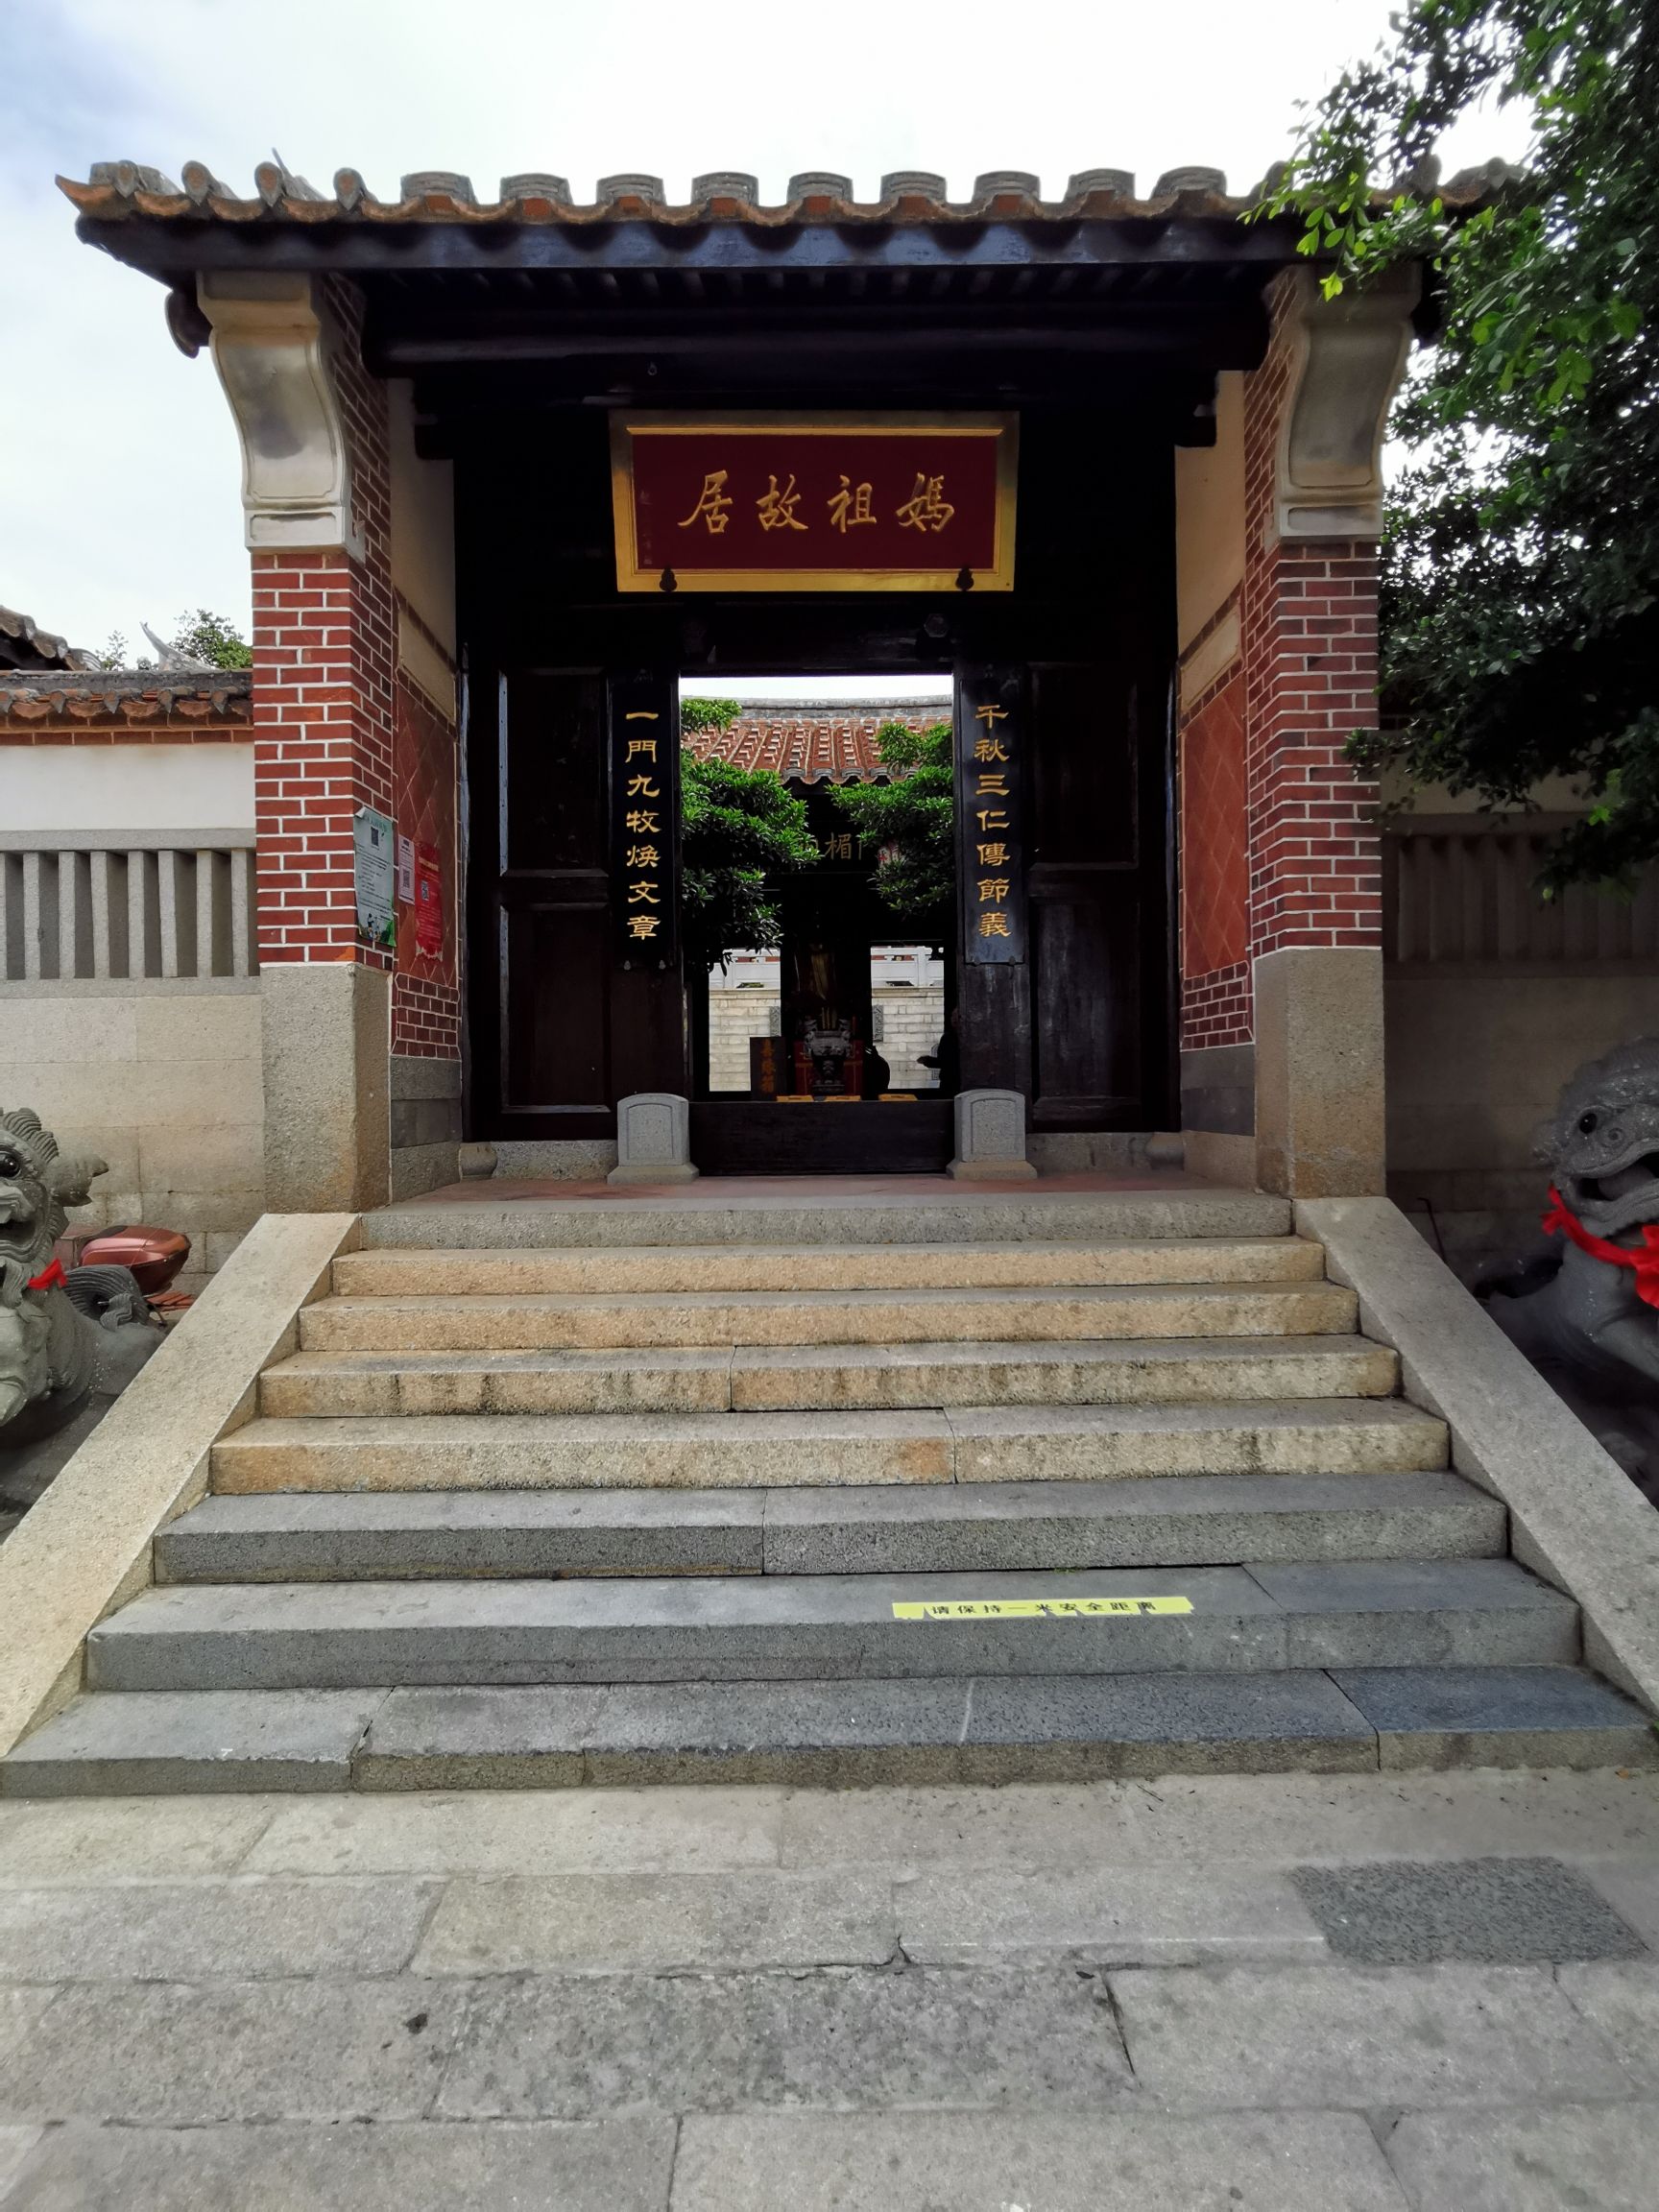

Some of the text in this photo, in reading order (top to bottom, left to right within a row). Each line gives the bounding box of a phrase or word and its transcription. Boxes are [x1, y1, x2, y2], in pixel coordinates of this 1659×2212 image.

[677, 469, 955, 534] 媽祖故居
[625, 711, 661, 940] 一門九牧煥文章
[931, 1600, 1157, 1615] 请保持一米安全距离
